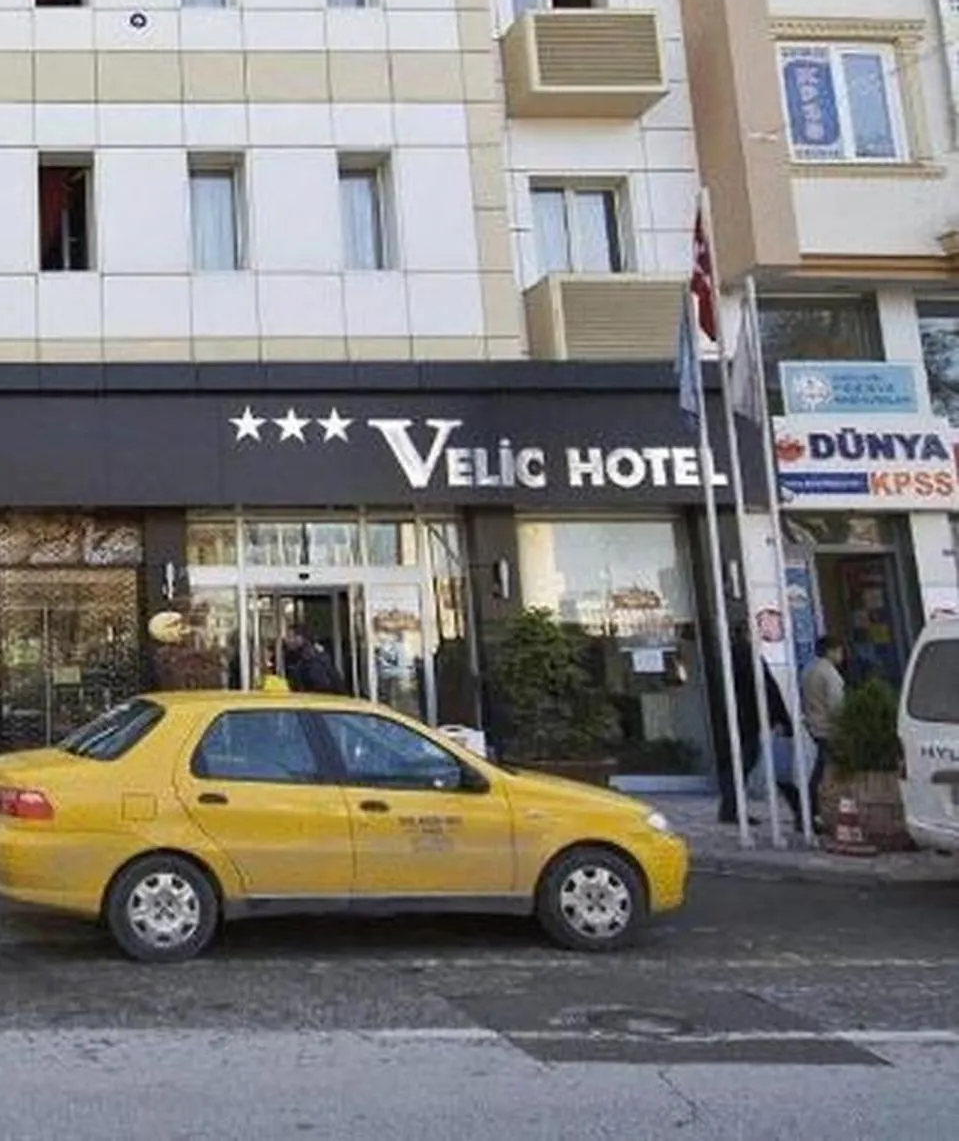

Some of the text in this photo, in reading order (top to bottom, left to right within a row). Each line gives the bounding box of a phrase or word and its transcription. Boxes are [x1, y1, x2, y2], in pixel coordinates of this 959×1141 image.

[808, 427, 950, 461] DÜNYA
[567, 446, 730, 488] HOTEL
[870, 470, 953, 496] KPSS
